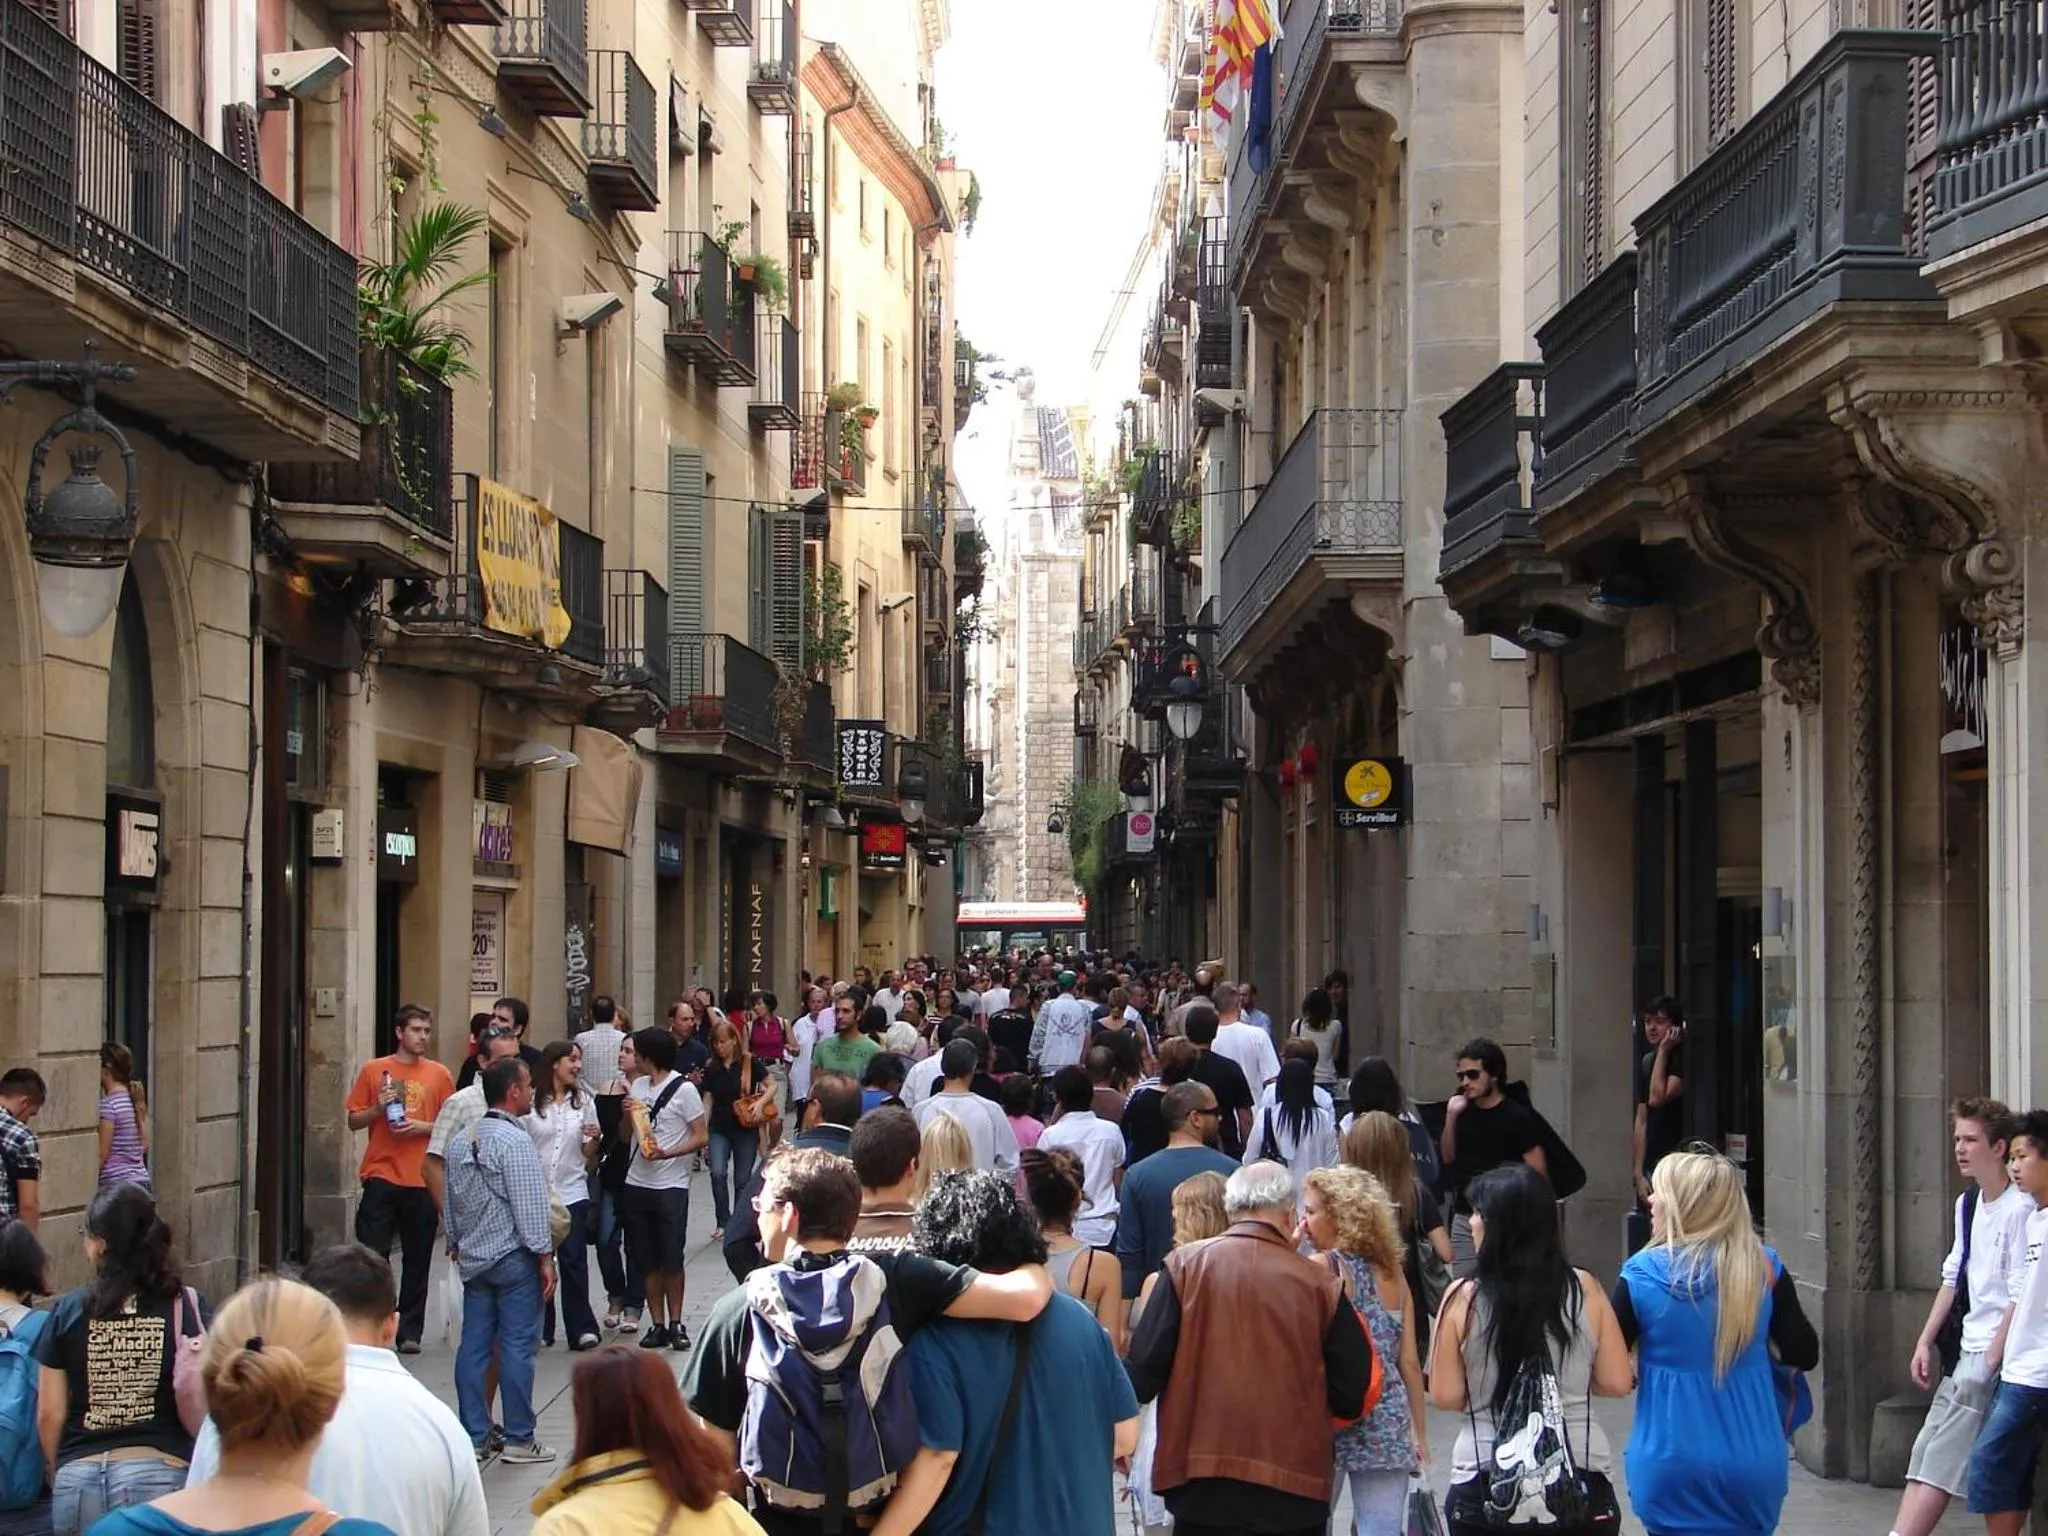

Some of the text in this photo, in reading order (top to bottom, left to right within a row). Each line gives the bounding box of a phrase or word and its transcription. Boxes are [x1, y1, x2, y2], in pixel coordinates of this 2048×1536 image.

[482, 492, 495, 553] ES
[855, 729, 868, 778] TATTOO
[751, 883, 762, 974] NAFNAF
[89, 1317, 134, 1331] Bogotá
[88, 1332, 109, 1343] Cali
[113, 1336, 164, 1350] Madrid
[87, 1351, 143, 1360] Washington
[87, 1360, 111, 1369] New
[112, 1358, 137, 1368] York
